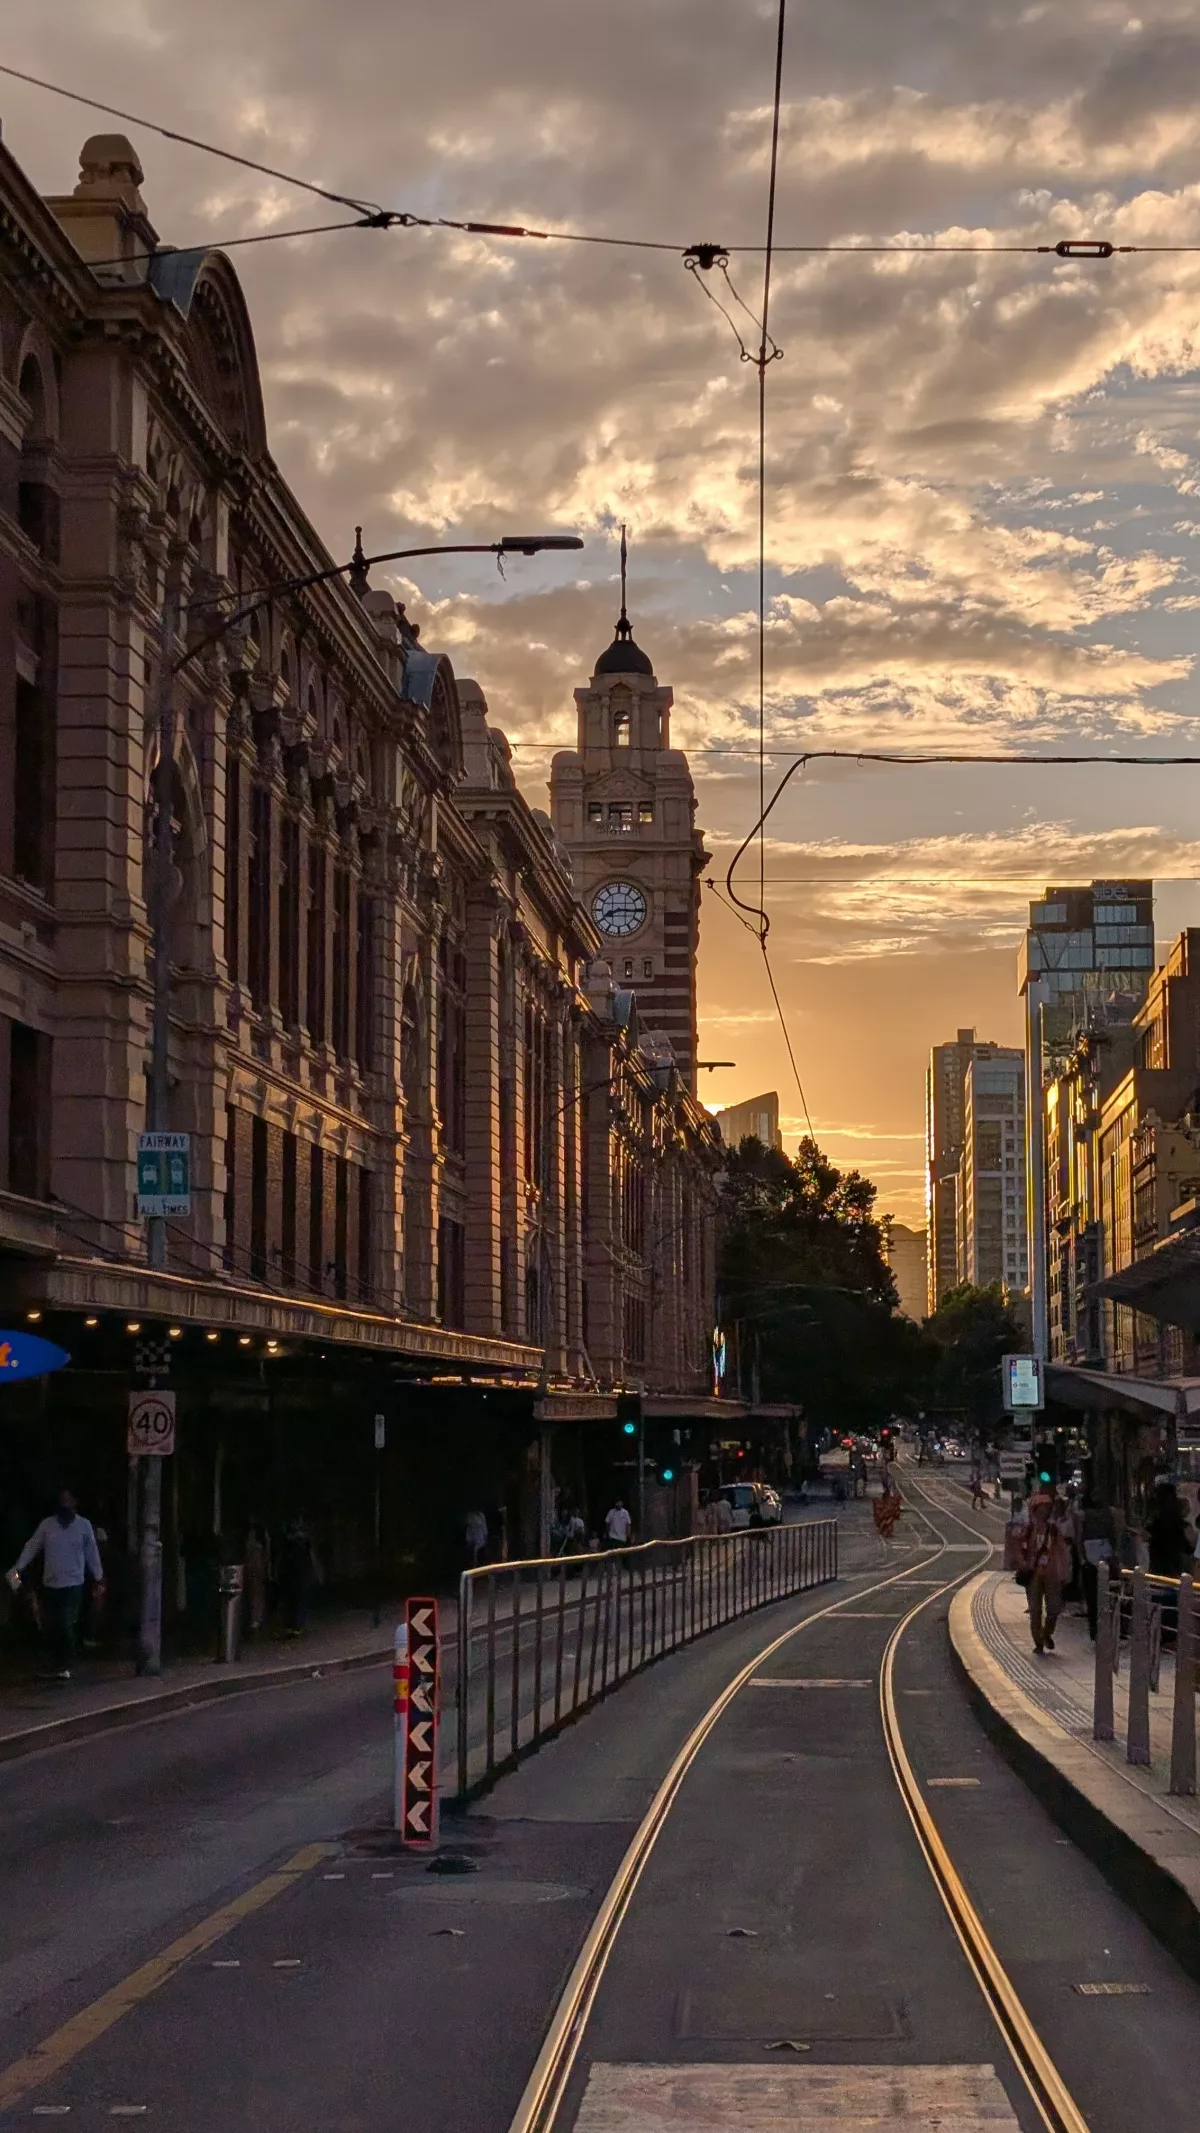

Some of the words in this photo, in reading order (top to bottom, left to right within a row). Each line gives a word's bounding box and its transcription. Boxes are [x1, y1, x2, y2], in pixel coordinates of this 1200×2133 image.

[140, 1135, 185, 1149] FAIRWAY
[141, 1204, 159, 1215] ALL
[163, 1203, 188, 1215] TIMES
[136, 1411, 169, 1434] 40
